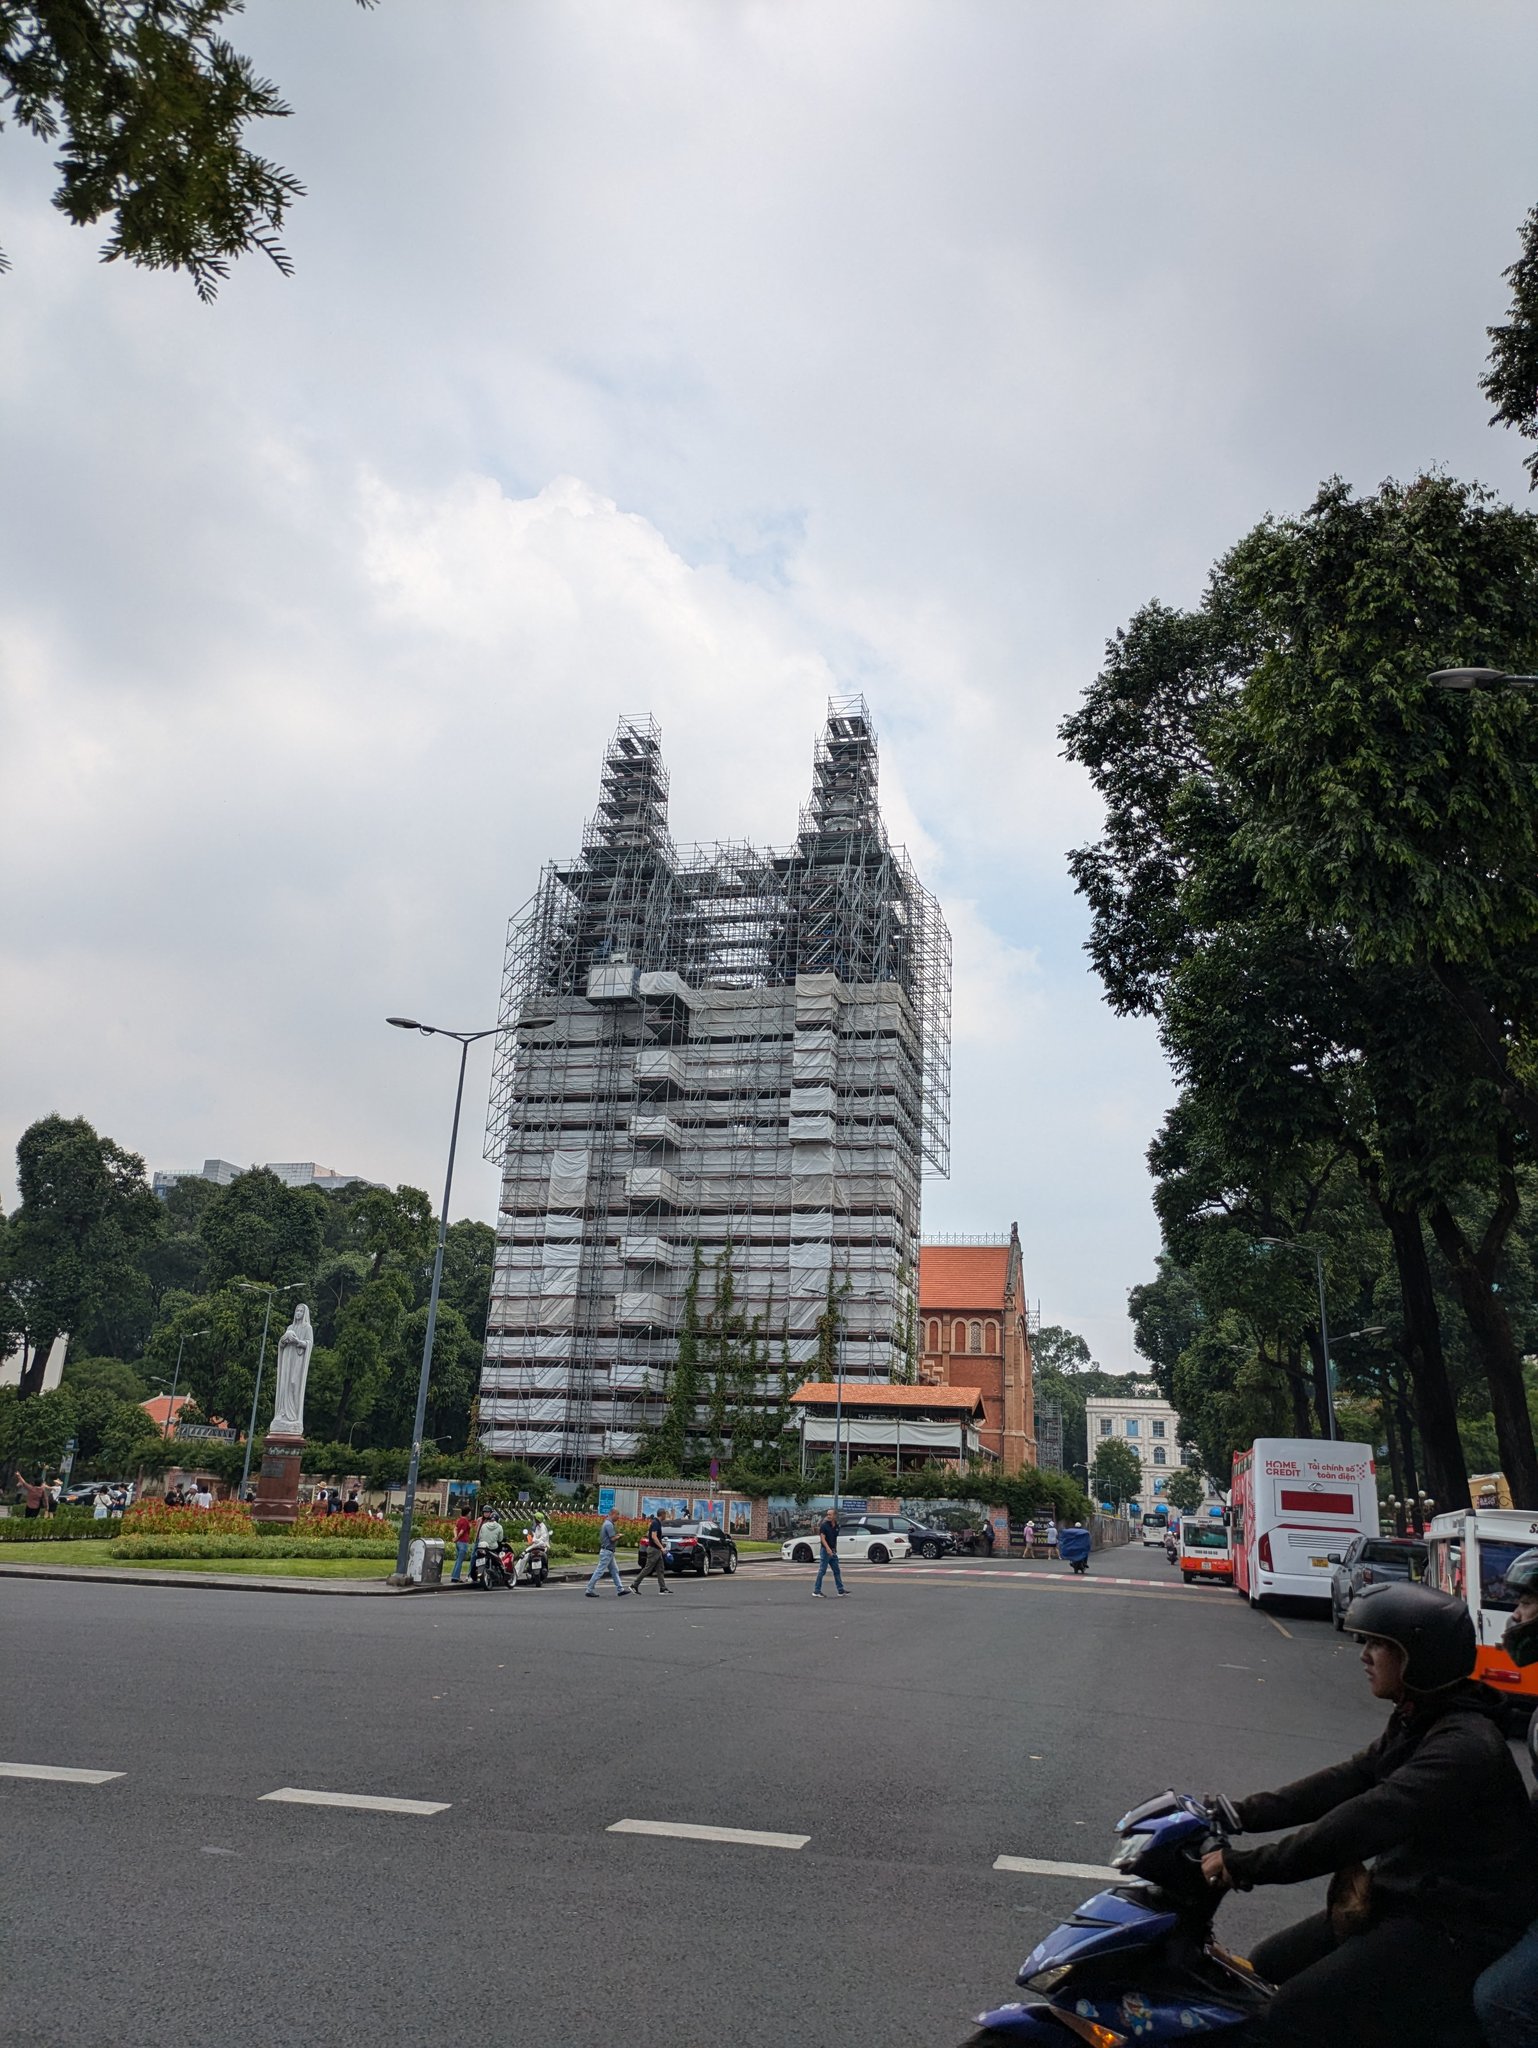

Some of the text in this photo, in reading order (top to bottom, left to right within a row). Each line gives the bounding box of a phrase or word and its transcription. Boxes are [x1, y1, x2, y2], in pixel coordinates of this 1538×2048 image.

[1265, 1460, 1297, 1469] HOME
[1321, 1463, 1344, 1472] chính
[1265, 1468, 1301, 1477] CREDIT
[1316, 1471, 1336, 1480] toàn
